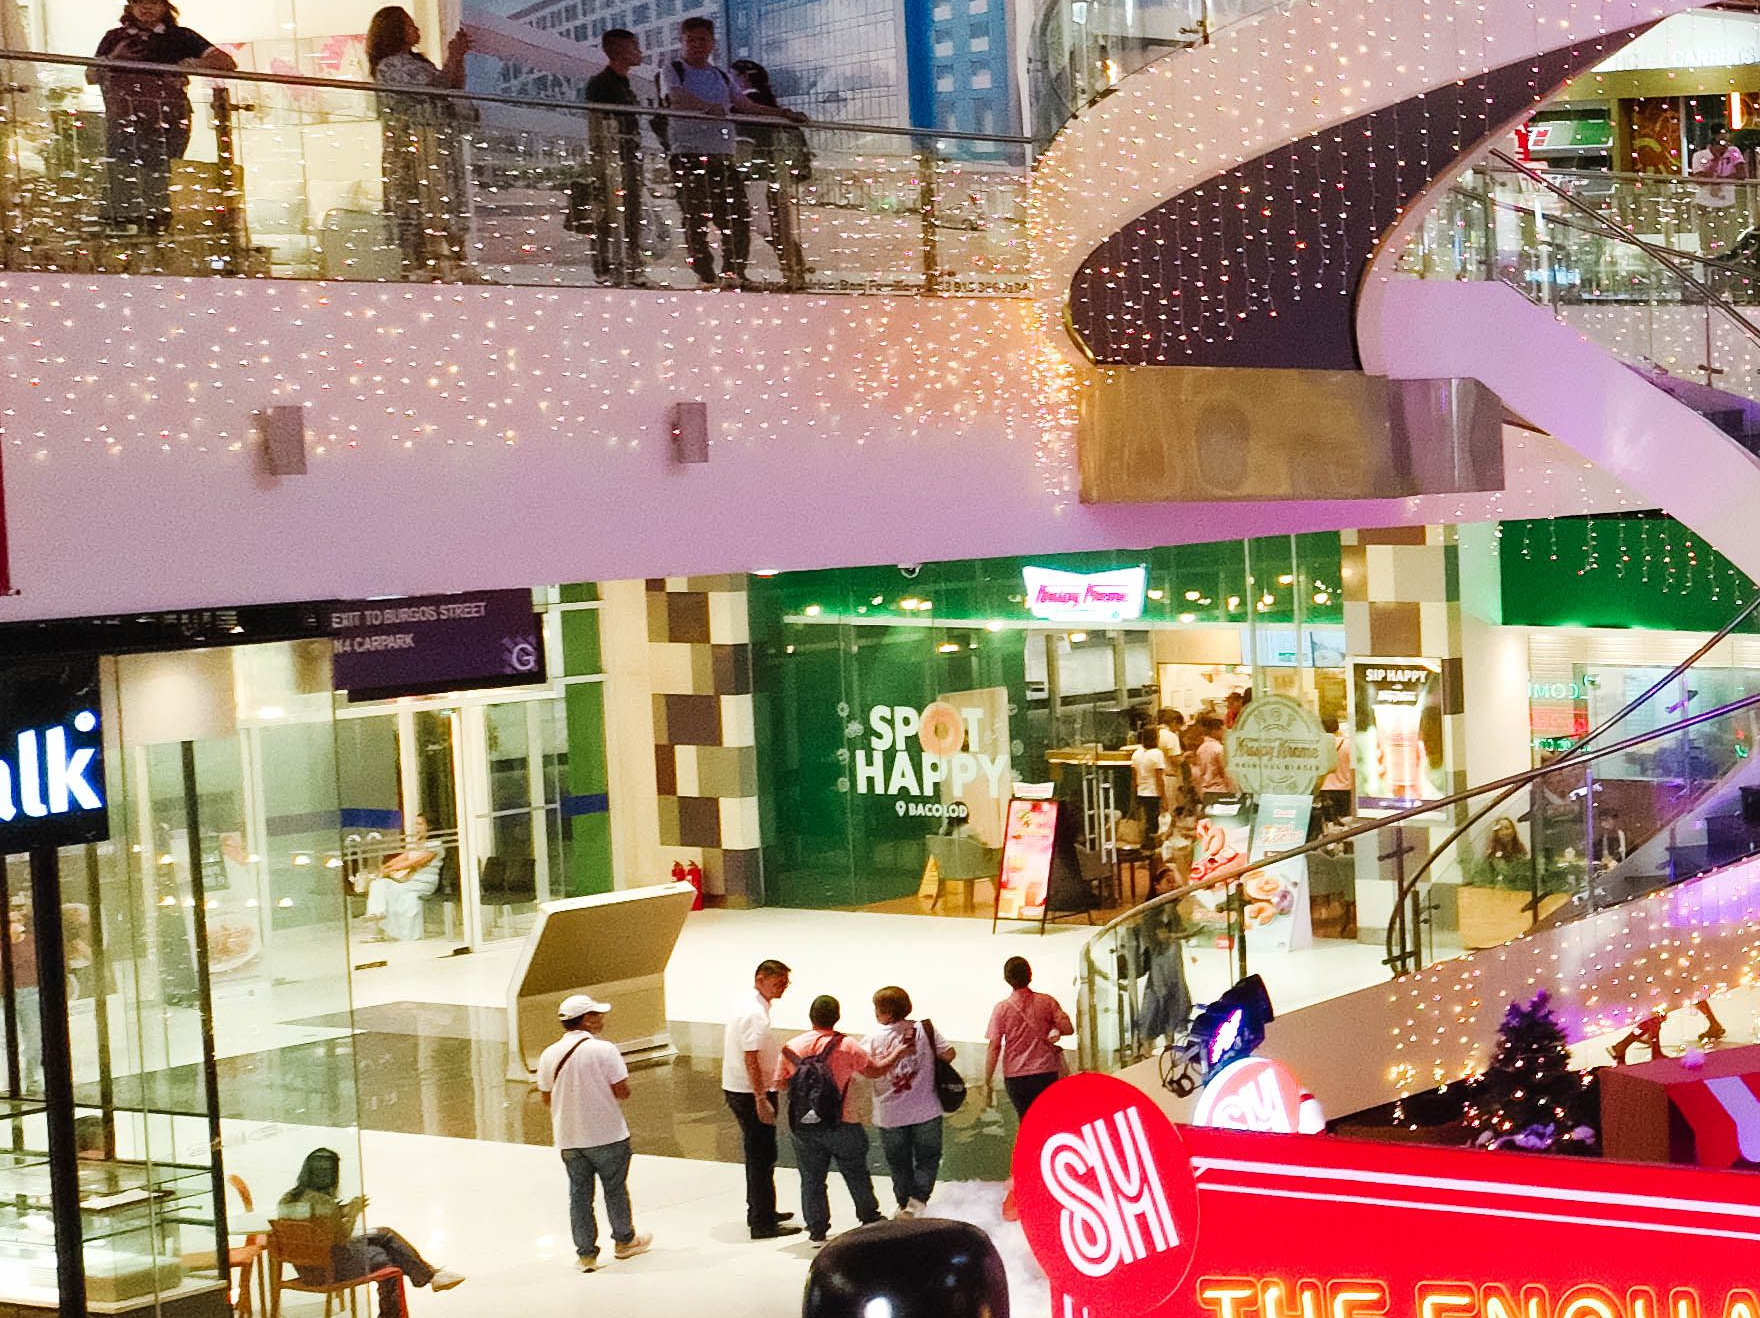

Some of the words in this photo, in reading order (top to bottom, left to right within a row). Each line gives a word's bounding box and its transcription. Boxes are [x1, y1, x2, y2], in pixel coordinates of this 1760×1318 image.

[331, 612, 362, 629] EXIT
[363, 610, 383, 626] TO
[383, 605, 438, 626] BURGOS
[439, 602, 487, 620] STREET
[353, 633, 416, 654] CARPARK
[1365, 668, 1386, 682] SIP
[1386, 668, 1429, 683] HAPPY
[868, 700, 985, 758] SPOT
[854, 748, 1010, 799] HAPPY
[907, 802, 969, 819] BACOLOD
[1040, 1105, 1180, 1278] SM
